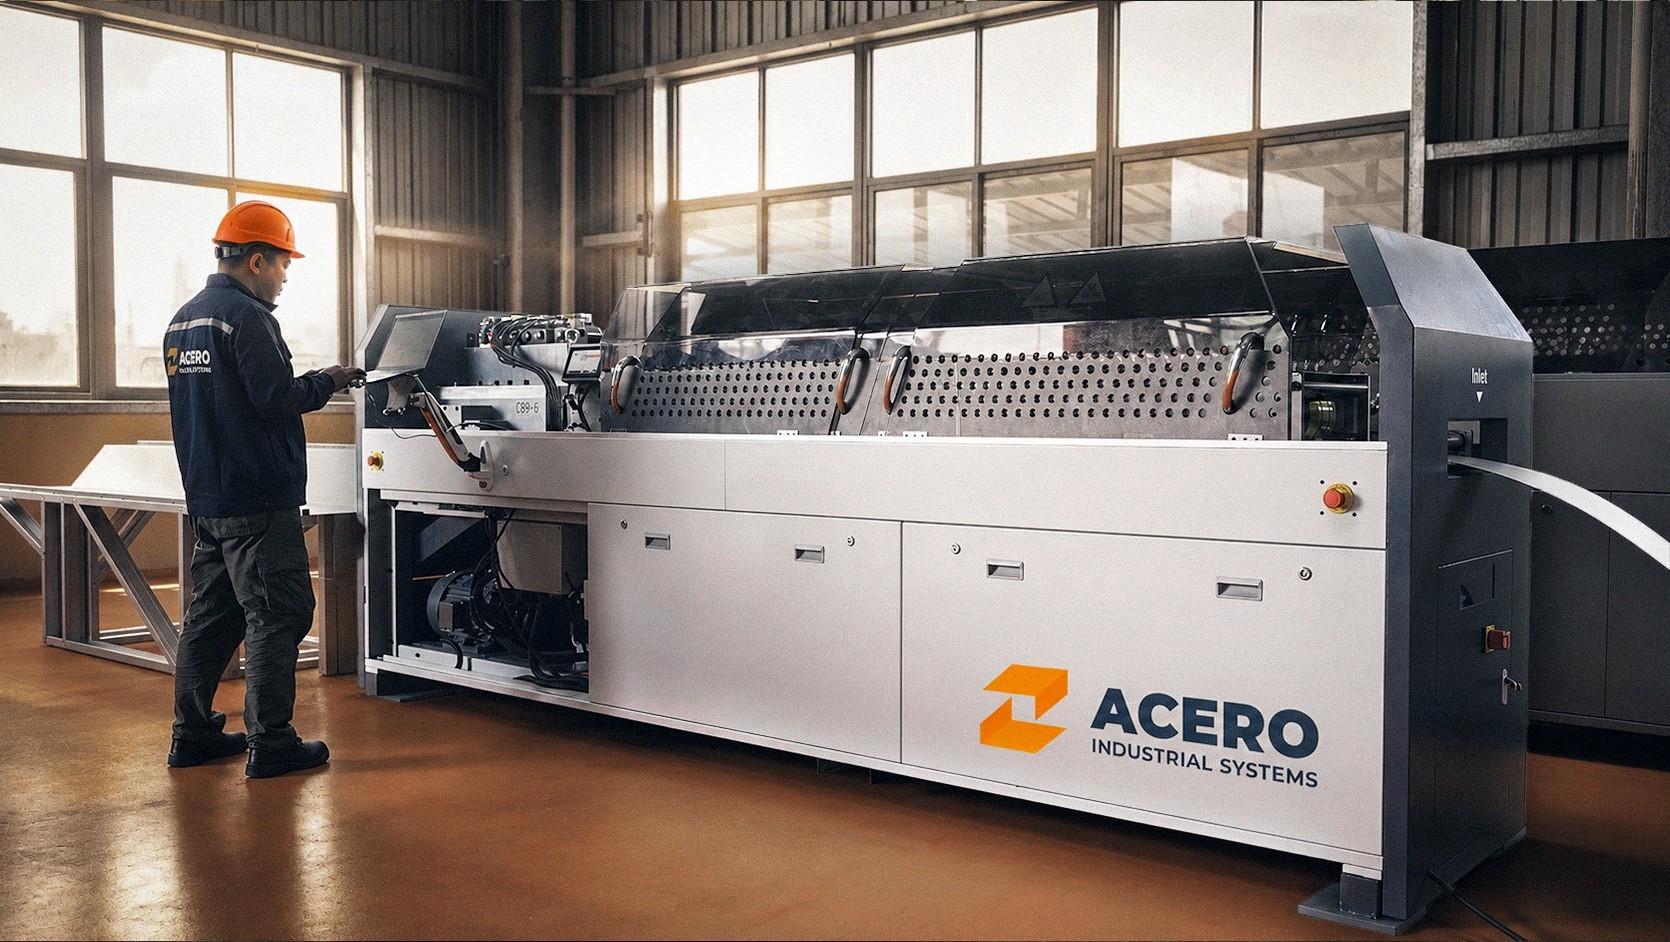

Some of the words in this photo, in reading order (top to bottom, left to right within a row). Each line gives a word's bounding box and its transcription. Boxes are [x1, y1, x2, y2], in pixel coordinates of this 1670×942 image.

[179, 350, 211, 365] ACERO
[1471, 367, 1488, 384] Inlet
[1090, 687, 1319, 759] ACERO
[1091, 738, 1213, 771] INDUSTRIAL
[1219, 758, 1319, 788] SYSTEMS
